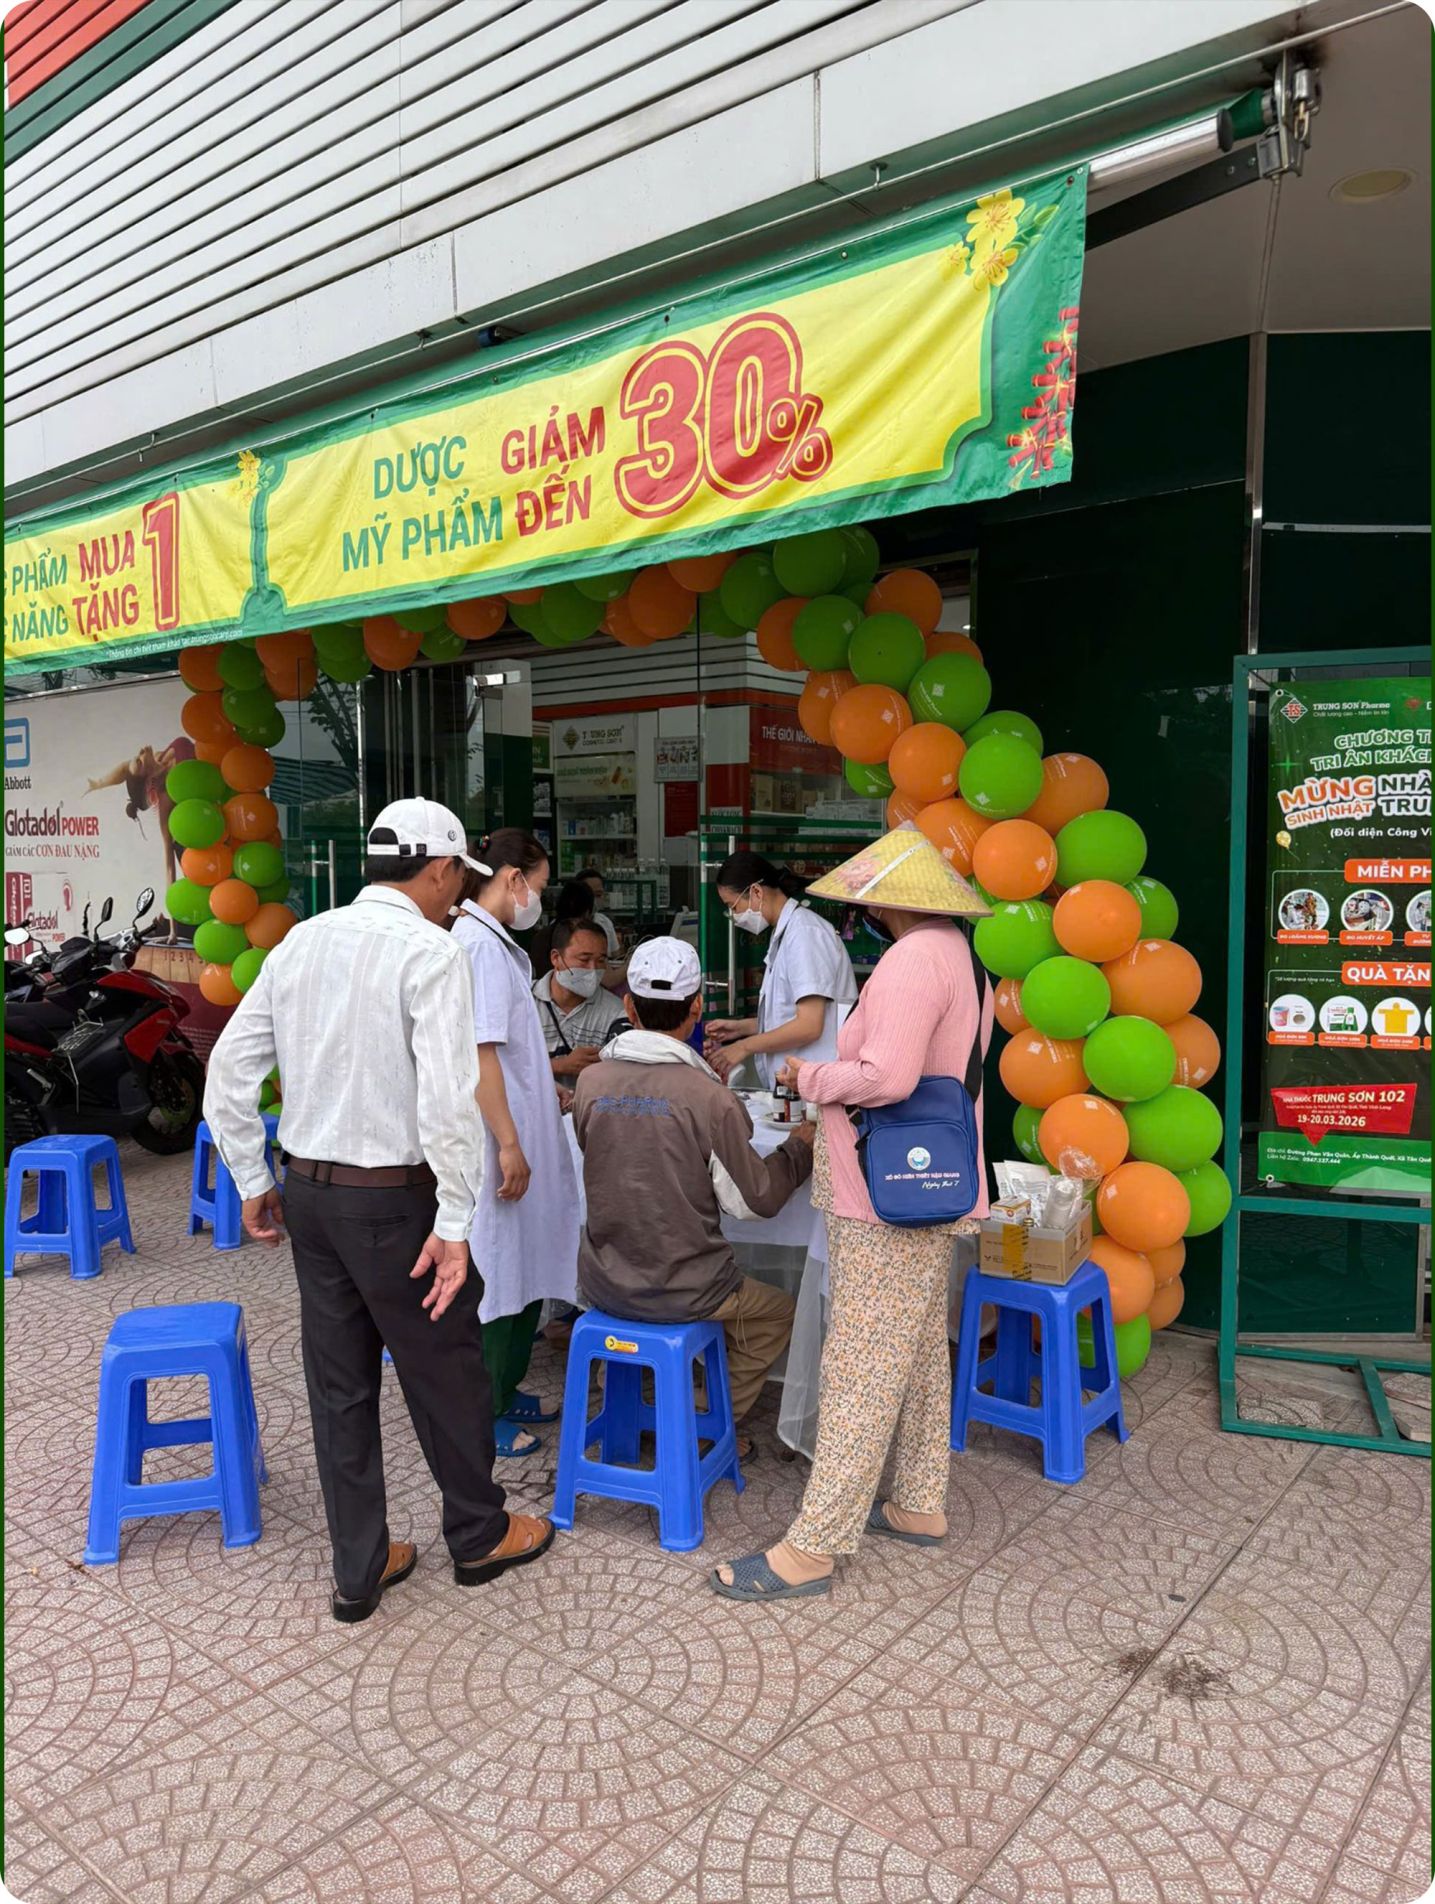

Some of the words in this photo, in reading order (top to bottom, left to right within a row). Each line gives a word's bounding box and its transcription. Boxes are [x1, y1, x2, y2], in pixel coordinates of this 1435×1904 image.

[373, 434, 467, 500] DƯỢC
[500, 404, 606, 476] GIẢM
[613, 311, 834, 519] 30%
[341, 516, 392, 573] MỸ
[401, 487, 504, 561] PHẨM
[515, 463, 592, 538] ĐẾN
[12, 546, 69, 597] PHẨM
[78, 529, 136, 583] MUA
[142, 492, 180, 632] 1
[12, 600, 70, 643] NĂNG
[72, 581, 140, 643] TẶNG
[1312, 702, 1341, 710] TRUNG
[1361, 701, 1390, 709] Pharma
[762, 723, 777, 740] THẾ
[1334, 728, 1414, 750] CHƯƠNG
[1311, 754, 1342, 772] TRI
[1344, 749, 1373, 767] ÂN
[4, 776, 32, 791] Abbott
[1278, 775, 1376, 813] MỪNG
[5, 806, 61, 837] Glotadol
[62, 816, 100, 836] POWER
[1284, 804, 1327, 830] SINH
[1327, 798, 1376, 821] NHẬT
[1330, 826, 1355, 839] (Đối
[1358, 826, 1384, 839] diện
[1387, 827, 1418, 839] Công
[55, 844, 73, 857] ĐAU
[74, 842, 100, 861] NẶNG
[1357, 859, 1404, 879] MIỄN
[1347, 964, 1388, 981] QUÀ
[1312, 1092, 1345, 1104] TRUNG
[1348, 1090, 1375, 1103] SƠN
[1378, 1090, 1405, 1103] 102
[1297, 1114, 1366, 1127] 19-20.03.2026
